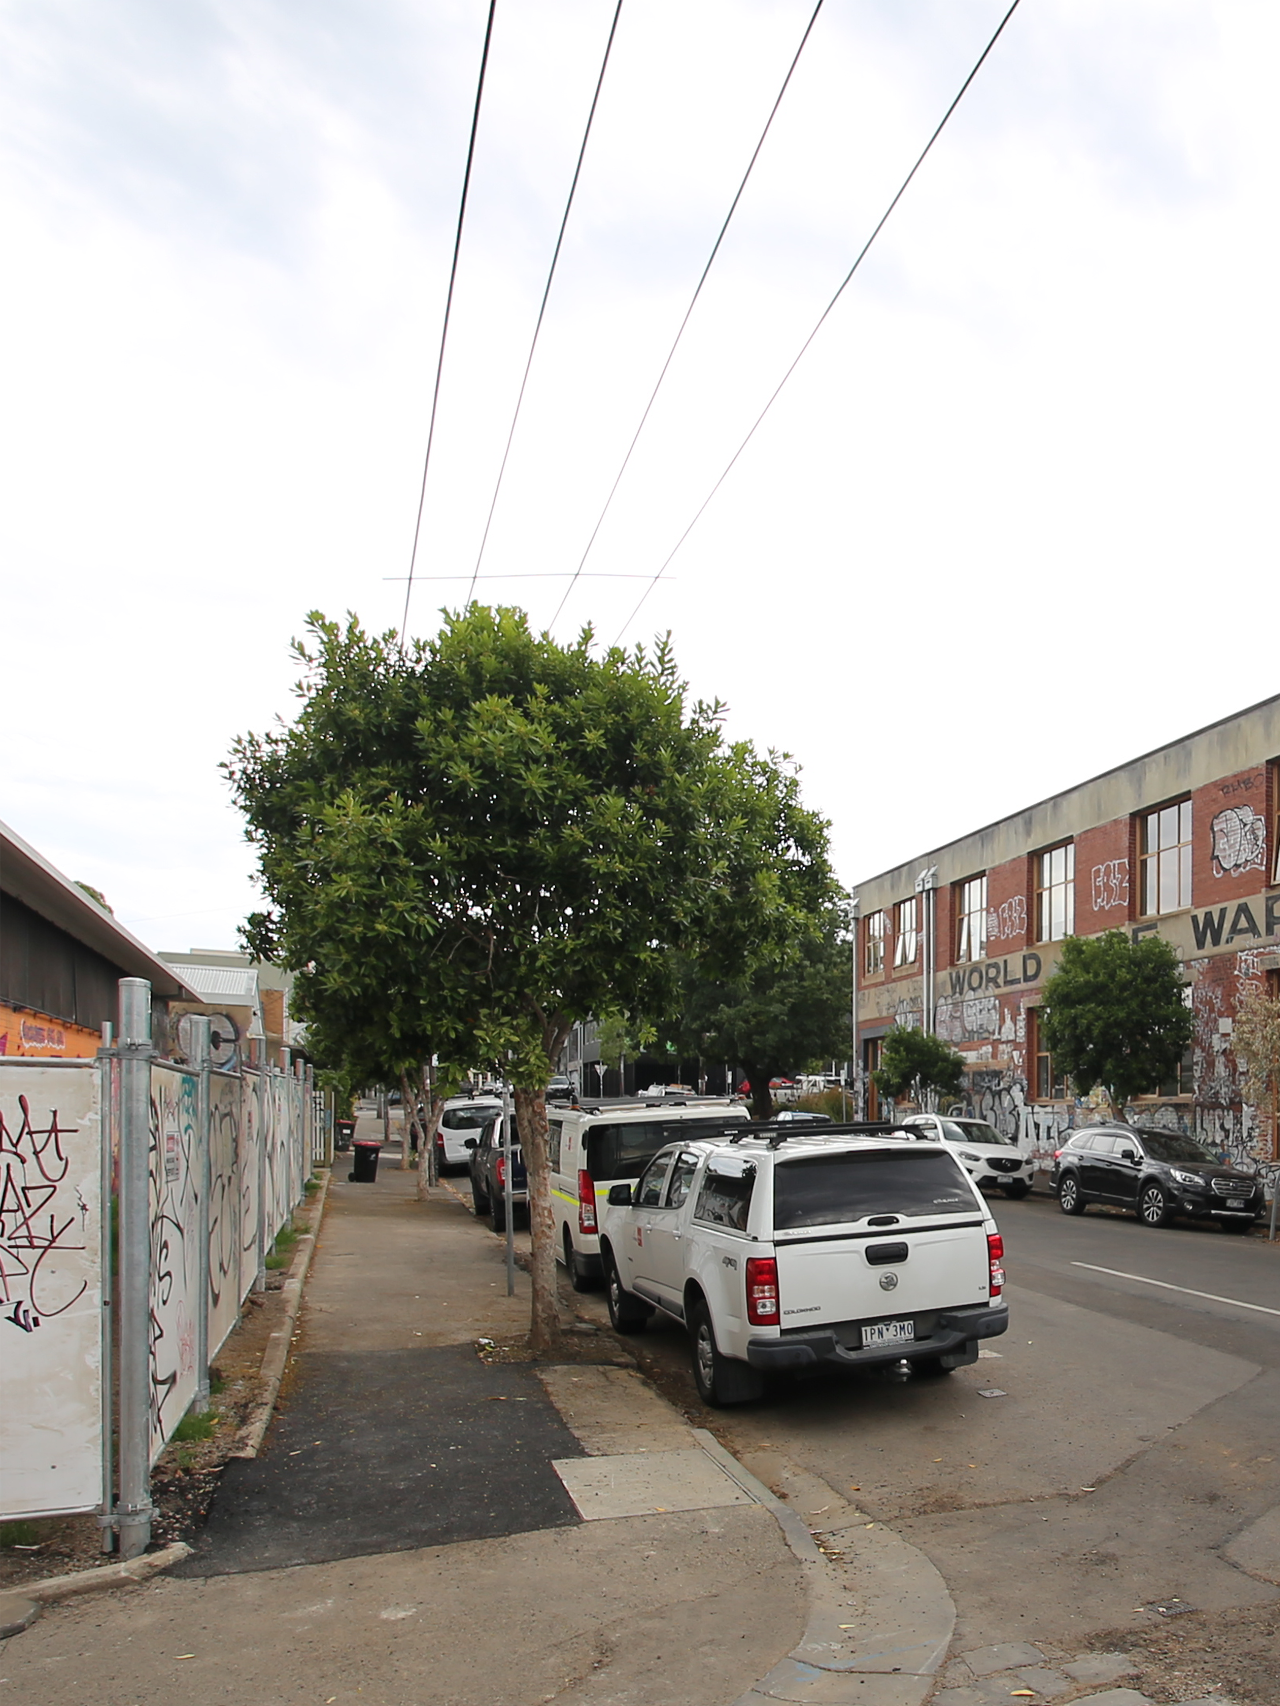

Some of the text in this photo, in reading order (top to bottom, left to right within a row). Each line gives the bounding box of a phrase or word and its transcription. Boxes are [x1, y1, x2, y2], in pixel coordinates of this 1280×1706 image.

[949, 953, 1041, 996] WORLD
[783, 1306, 821, 1315] COLORADO
[864, 1325, 884, 1342] 1PN
